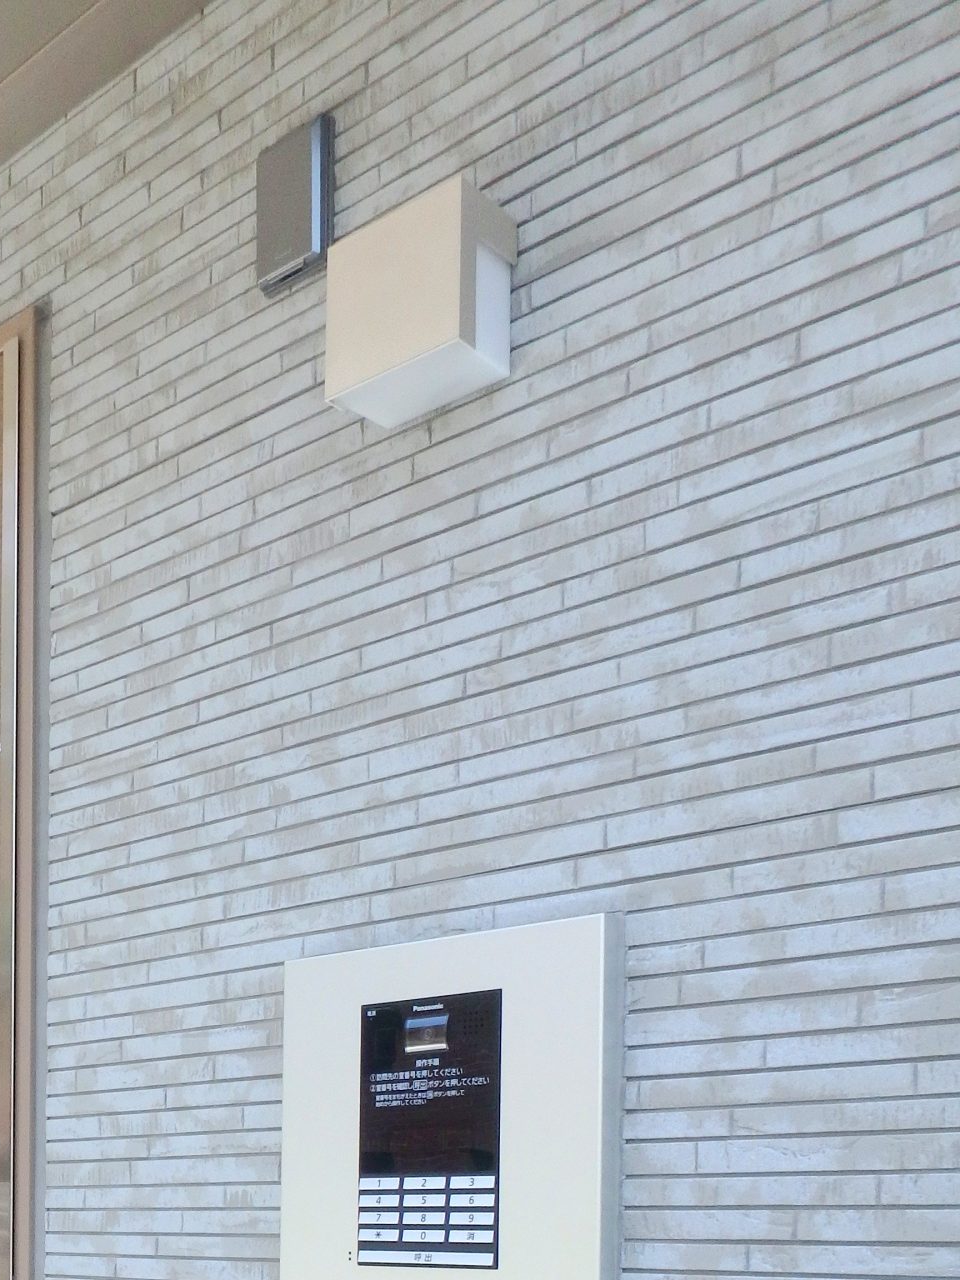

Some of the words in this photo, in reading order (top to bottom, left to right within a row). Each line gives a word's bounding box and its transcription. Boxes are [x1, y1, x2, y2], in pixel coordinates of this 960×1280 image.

[413, 1003, 443, 1012] Panasonic
[421, 1178, 427, 1188] 2
[468, 1177, 475, 1187] 3
[375, 1196, 382, 1204] 4
[421, 1195, 427, 1205] 5
[468, 1195, 475, 1205] 6
[376, 1213, 382, 1222] 7
[420, 1213, 427, 1223] 8
[468, 1213, 475, 1223] 9
[420, 1231, 427, 1241] 0
